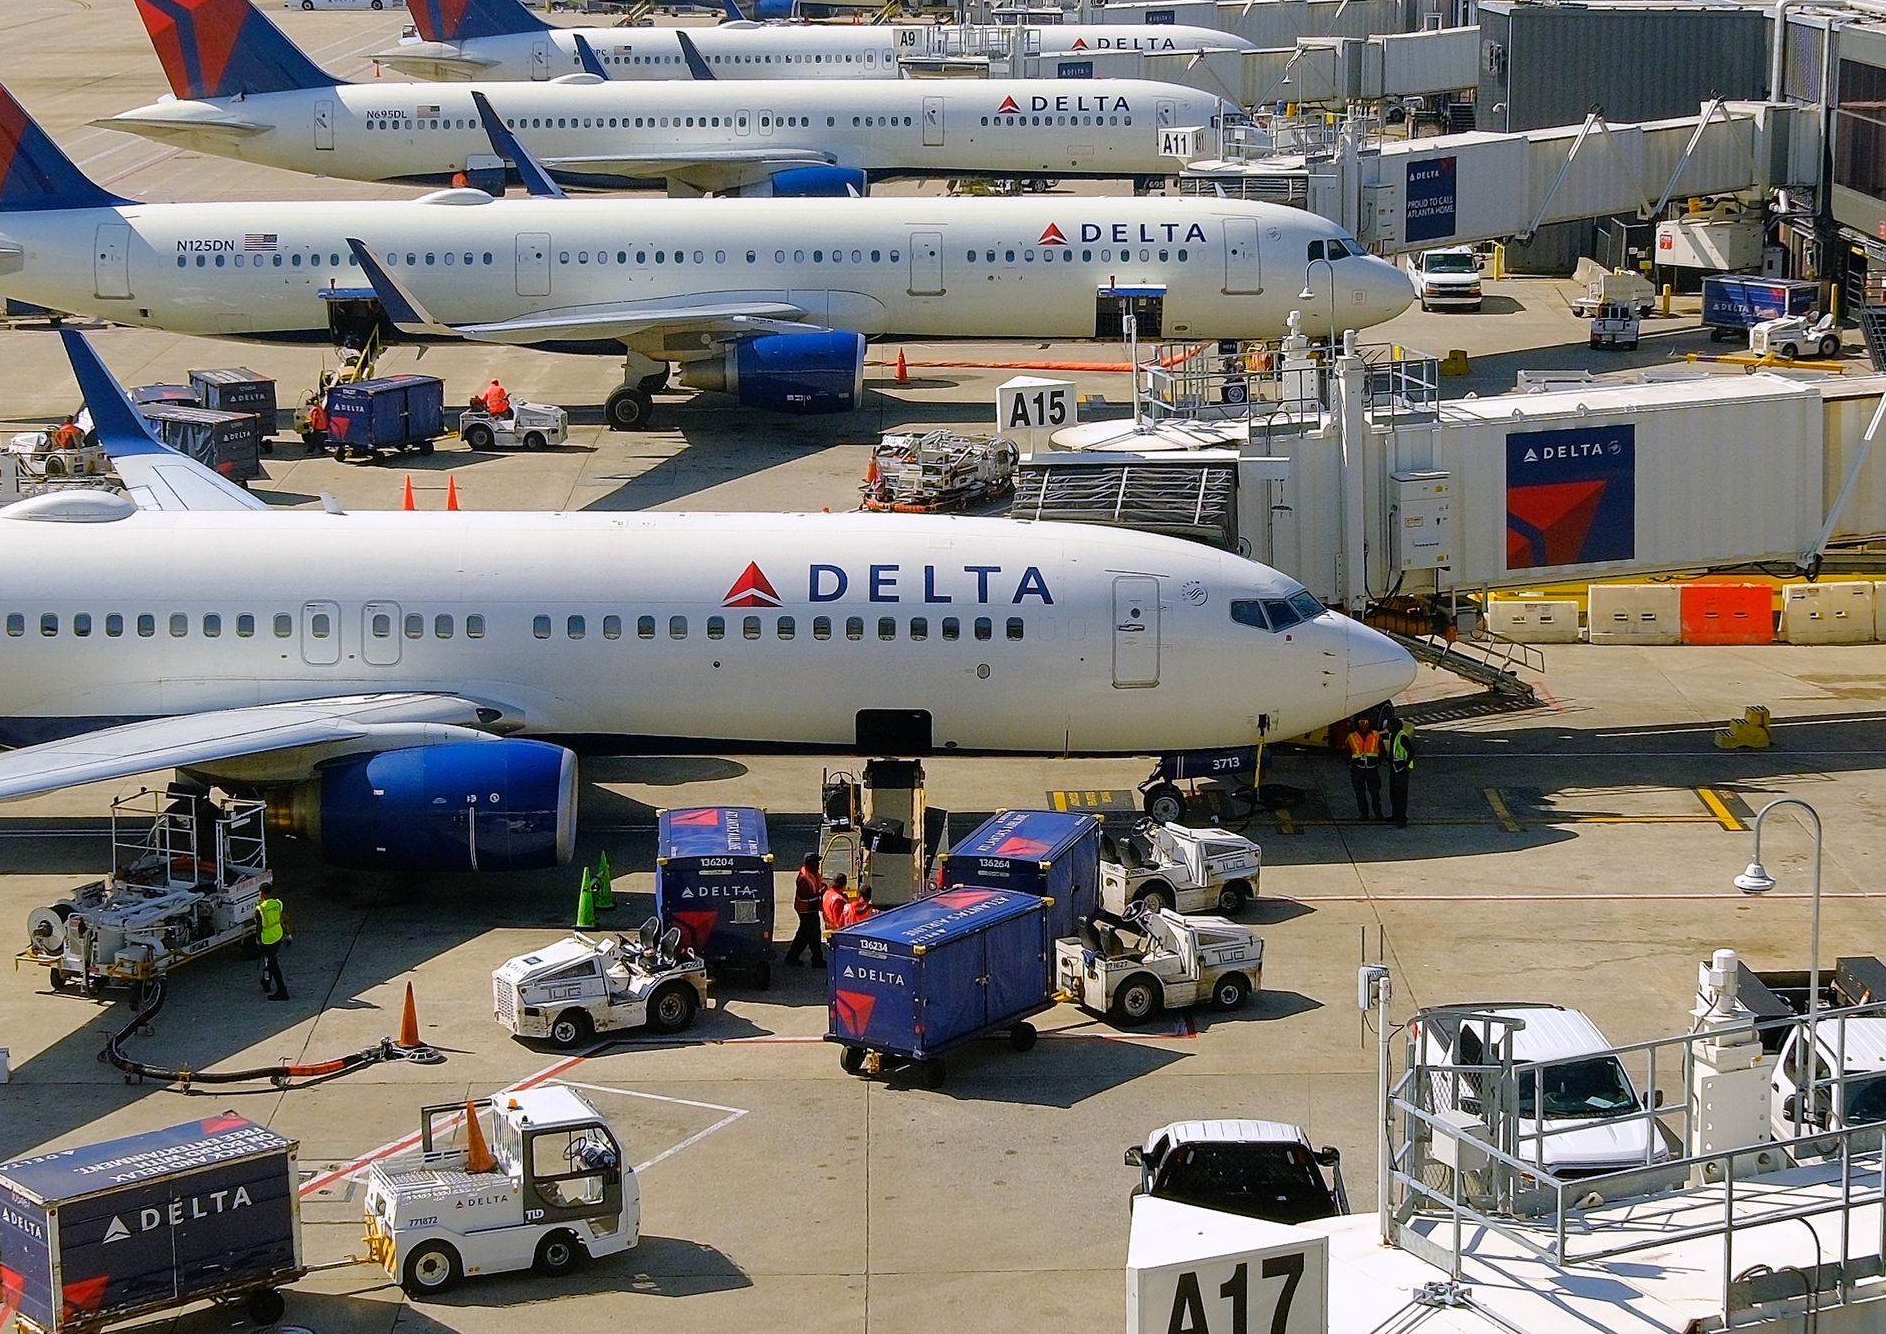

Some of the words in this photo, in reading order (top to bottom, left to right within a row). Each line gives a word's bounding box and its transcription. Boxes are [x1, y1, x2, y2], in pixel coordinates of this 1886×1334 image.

[900, 31, 915, 47] A9
[1097, 38, 1175, 50] DELTA
[1031, 96, 1130, 112] DELTA
[366, 110, 407, 119] N695DL
[1163, 133, 1187, 155] A11
[1417, 170, 1440, 180] DELTA
[1408, 199, 1429, 209] PROUD
[1438, 196, 1454, 205] CALL
[1407, 207, 1434, 218] ATLANTA
[1082, 224, 1206, 243] DELTA
[177, 240, 234, 251] N125DN
[1722, 303, 1749, 314] DELTA
[238, 393, 265, 402] DELTA
[341, 405, 364, 414] DELTA
[1009, 389, 1066, 428] A15
[230, 430, 251, 440] DELTA
[1543, 443, 1602, 459] DELTA
[808, 564, 1055, 605] DELTA
[1212, 757, 1240, 770] 3713
[701, 858, 734, 868] 136204
[979, 858, 1011, 869] 136264
[1217, 855, 1245, 871] TUG
[699, 886, 754, 897] DELTA
[860, 939, 888, 953] 136234
[1212, 946, 1245, 963] TUG
[858, 967, 904, 986] DELTA
[541, 983, 581, 999] TUG
[219, 1127, 265, 1142] FREE
[246, 1133, 275, 1144] ON
[185, 1140, 247, 1157] BOARD
[259, 1137, 287, 1149] SIT
[208, 1146, 258, 1159] BACK
[134, 1152, 186, 1169] WITH
[170, 1156, 207, 1168] AND
[109, 1165, 170, 1183] RELAX
[468, 1195, 509, 1207] DELTA
[140, 1186, 252, 1231] DELTA
[525, 1208, 545, 1222] TLD
[10, 1212, 43, 1240] DELTA
[409, 1216, 438, 1227] 771872
